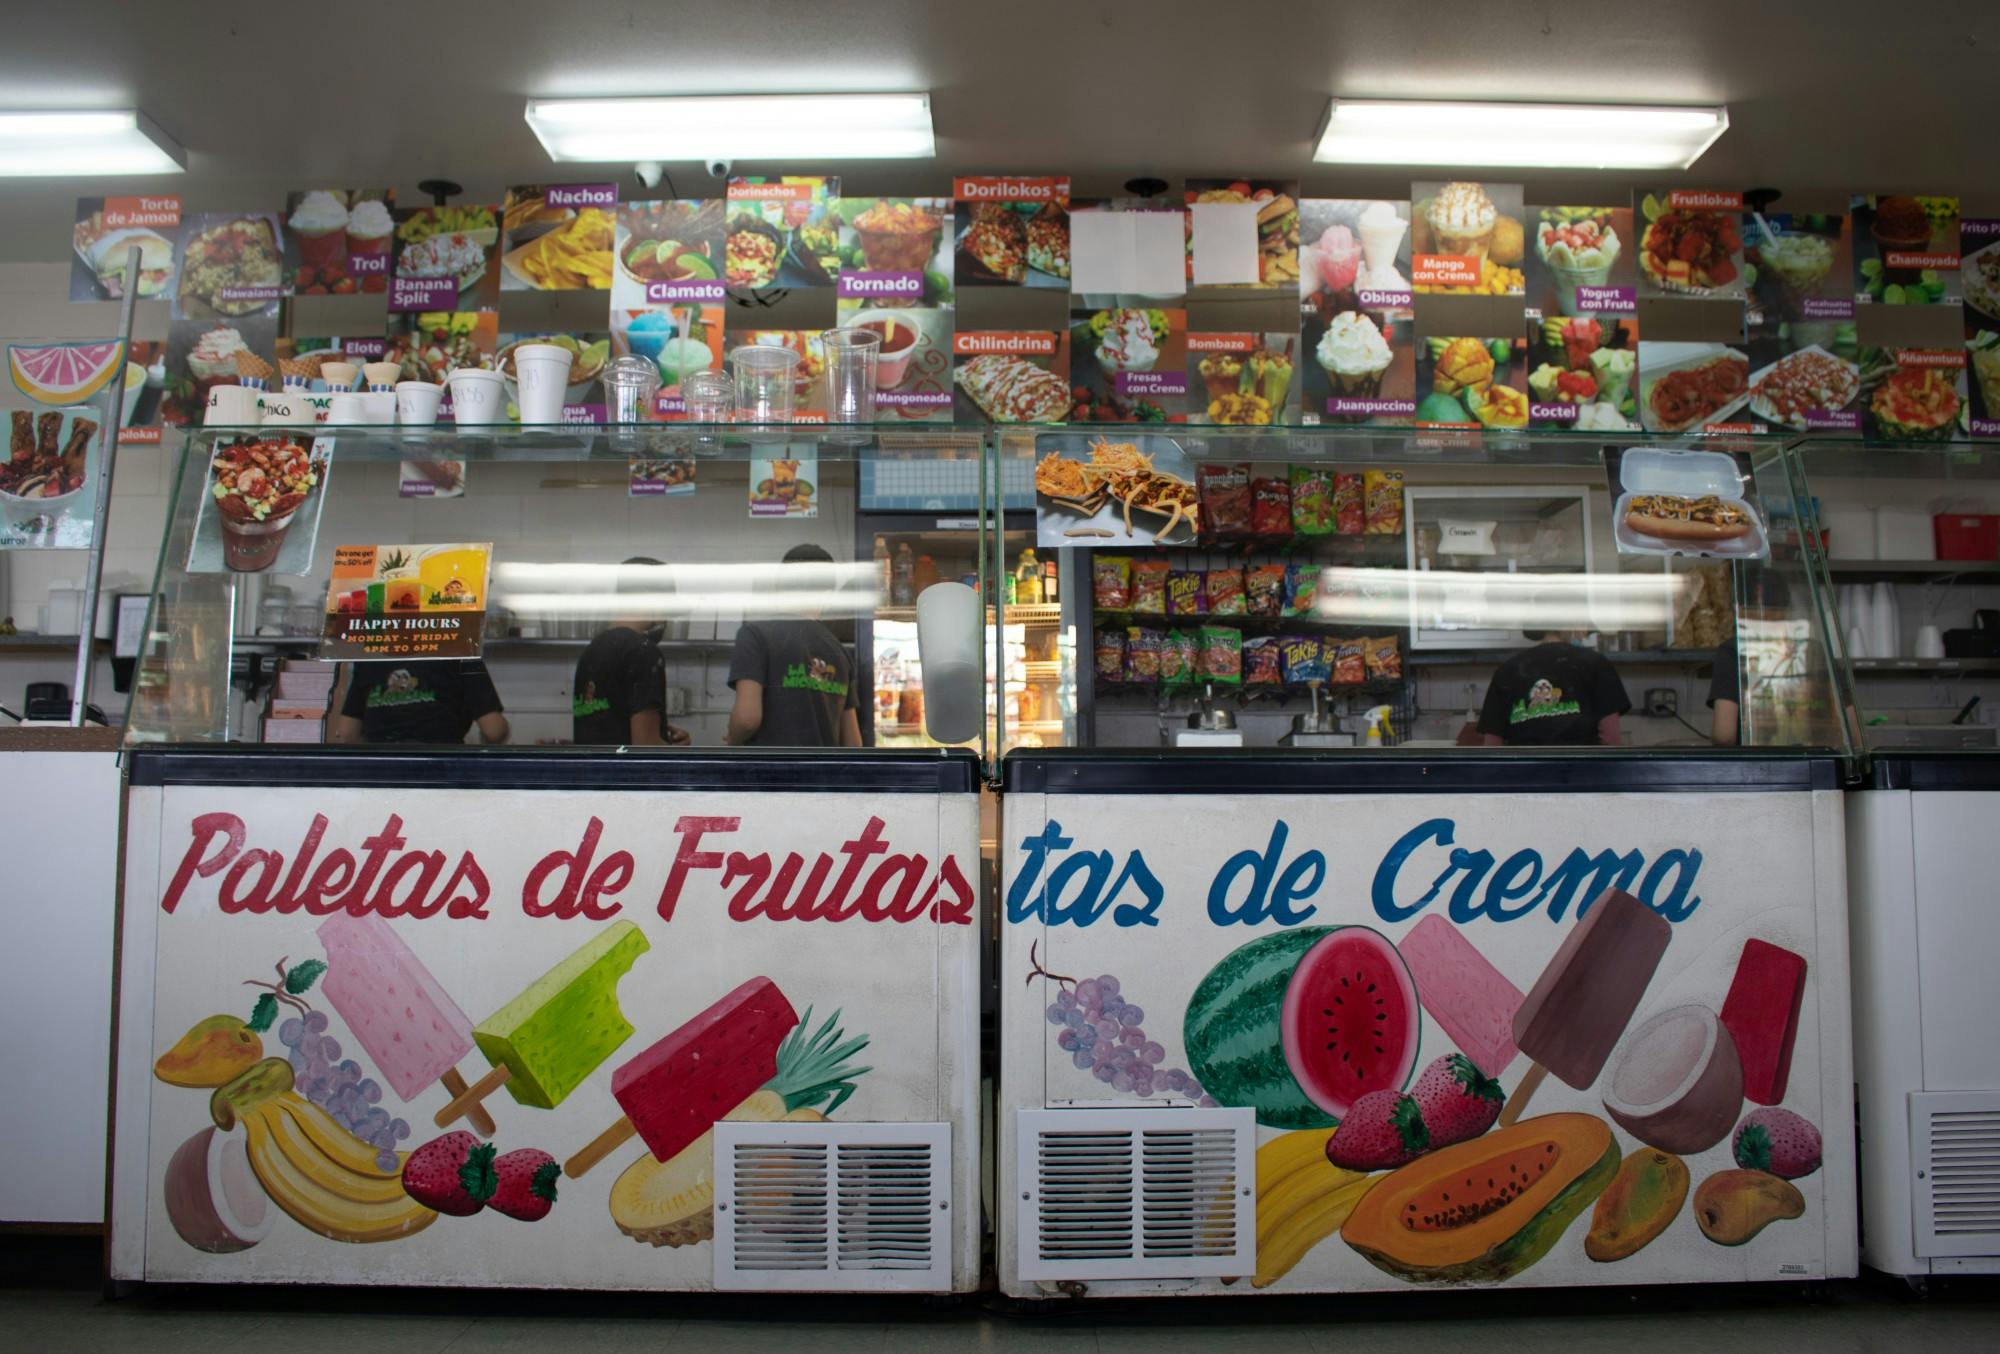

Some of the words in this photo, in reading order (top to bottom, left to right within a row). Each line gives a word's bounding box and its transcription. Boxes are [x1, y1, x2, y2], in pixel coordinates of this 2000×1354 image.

[549, 188, 614, 204] Nachos
[728, 186, 797, 198] Dorinachos
[963, 182, 1051, 197] Dorilokos
[139, 199, 178, 210] Torta
[1671, 192, 1739, 207] Frutilokas
[107, 212, 125, 224] de
[128, 212, 178, 225] Jamon
[1960, 223, 1987, 234] Frito
[352, 256, 385, 270] Trol
[1423, 258, 1465, 271] Mango
[1888, 254, 1959, 268] Chamoyada
[1413, 271, 1435, 281] con
[1437, 270, 1475, 281] Crema
[395, 279, 453, 291] Banana
[842, 276, 919, 291] Tornado
[222, 288, 278, 299] Hawaiana
[649, 283, 725, 298] Clamato
[1580, 287, 1620, 301] Yogurt
[394, 291, 430, 306] Split
[1360, 291, 1411, 305] Obispo
[1580, 300, 1601, 310] con
[1604, 299, 1635, 310] Fruta
[1803, 308, 1852, 317] Preparados
[346, 342, 382, 354] Elote
[957, 335, 1052, 350] Chilindrina
[1188, 338, 1245, 349] Bombazo
[1899, 353, 1964, 366] Piñaventura
[1127, 372, 1162, 382] Fresas
[1127, 385, 1148, 394] con
[1150, 383, 1186, 394] Crema
[876, 393, 951, 406] Mangoneada
[563, 406, 587, 417] gua
[1335, 400, 1415, 414] Juanpuccino
[1531, 405, 1576, 418] Coctel
[560, 413, 595, 424] neral
[1829, 411, 1856, 421] Papas
[118, 429, 159, 442] pilokas
[0, 536, 27, 545] urros
[1168, 574, 1201, 600] Takis
[349, 618, 401, 631] HAPPY
[404, 617, 461, 629] HOURS
[347, 633, 400, 643] MONDAY
[412, 632, 459, 642] FRIDAY
[393, 645, 409, 653] TO
[413, 643, 438, 652] 6PM
[1283, 641, 1319, 668] Takis
[160, 812, 490, 920] Paletas
[522, 815, 635, 921] de
[656, 814, 976, 926] Frutas
[1006, 818, 1165, 928] tas
[1206, 819, 1327, 927] de
[1371, 817, 1704, 925] Crema
